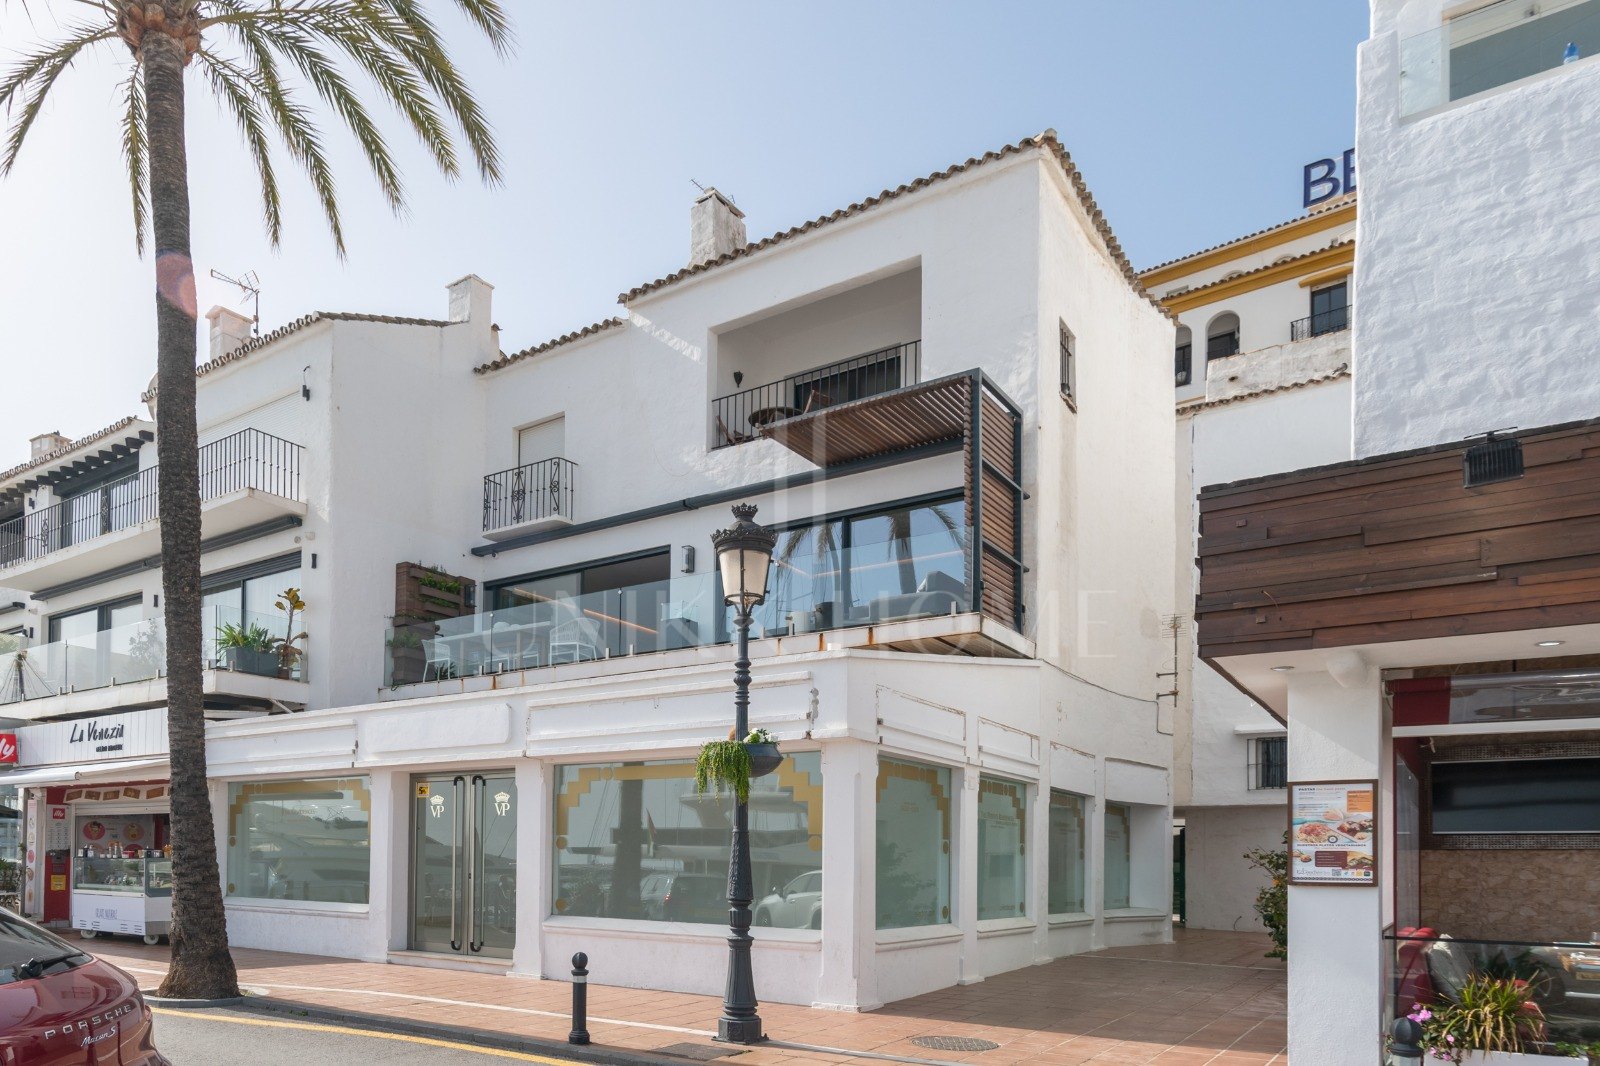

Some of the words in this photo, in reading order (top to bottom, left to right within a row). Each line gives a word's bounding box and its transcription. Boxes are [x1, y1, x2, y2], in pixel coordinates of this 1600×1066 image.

[69, 723, 84, 744] La
[87, 720, 125, 742] Venezia
[44, 1004, 132, 1040] PORSCHE
[80, 1032, 108, 1047] Macan
[107, 1025, 117, 1038] S
